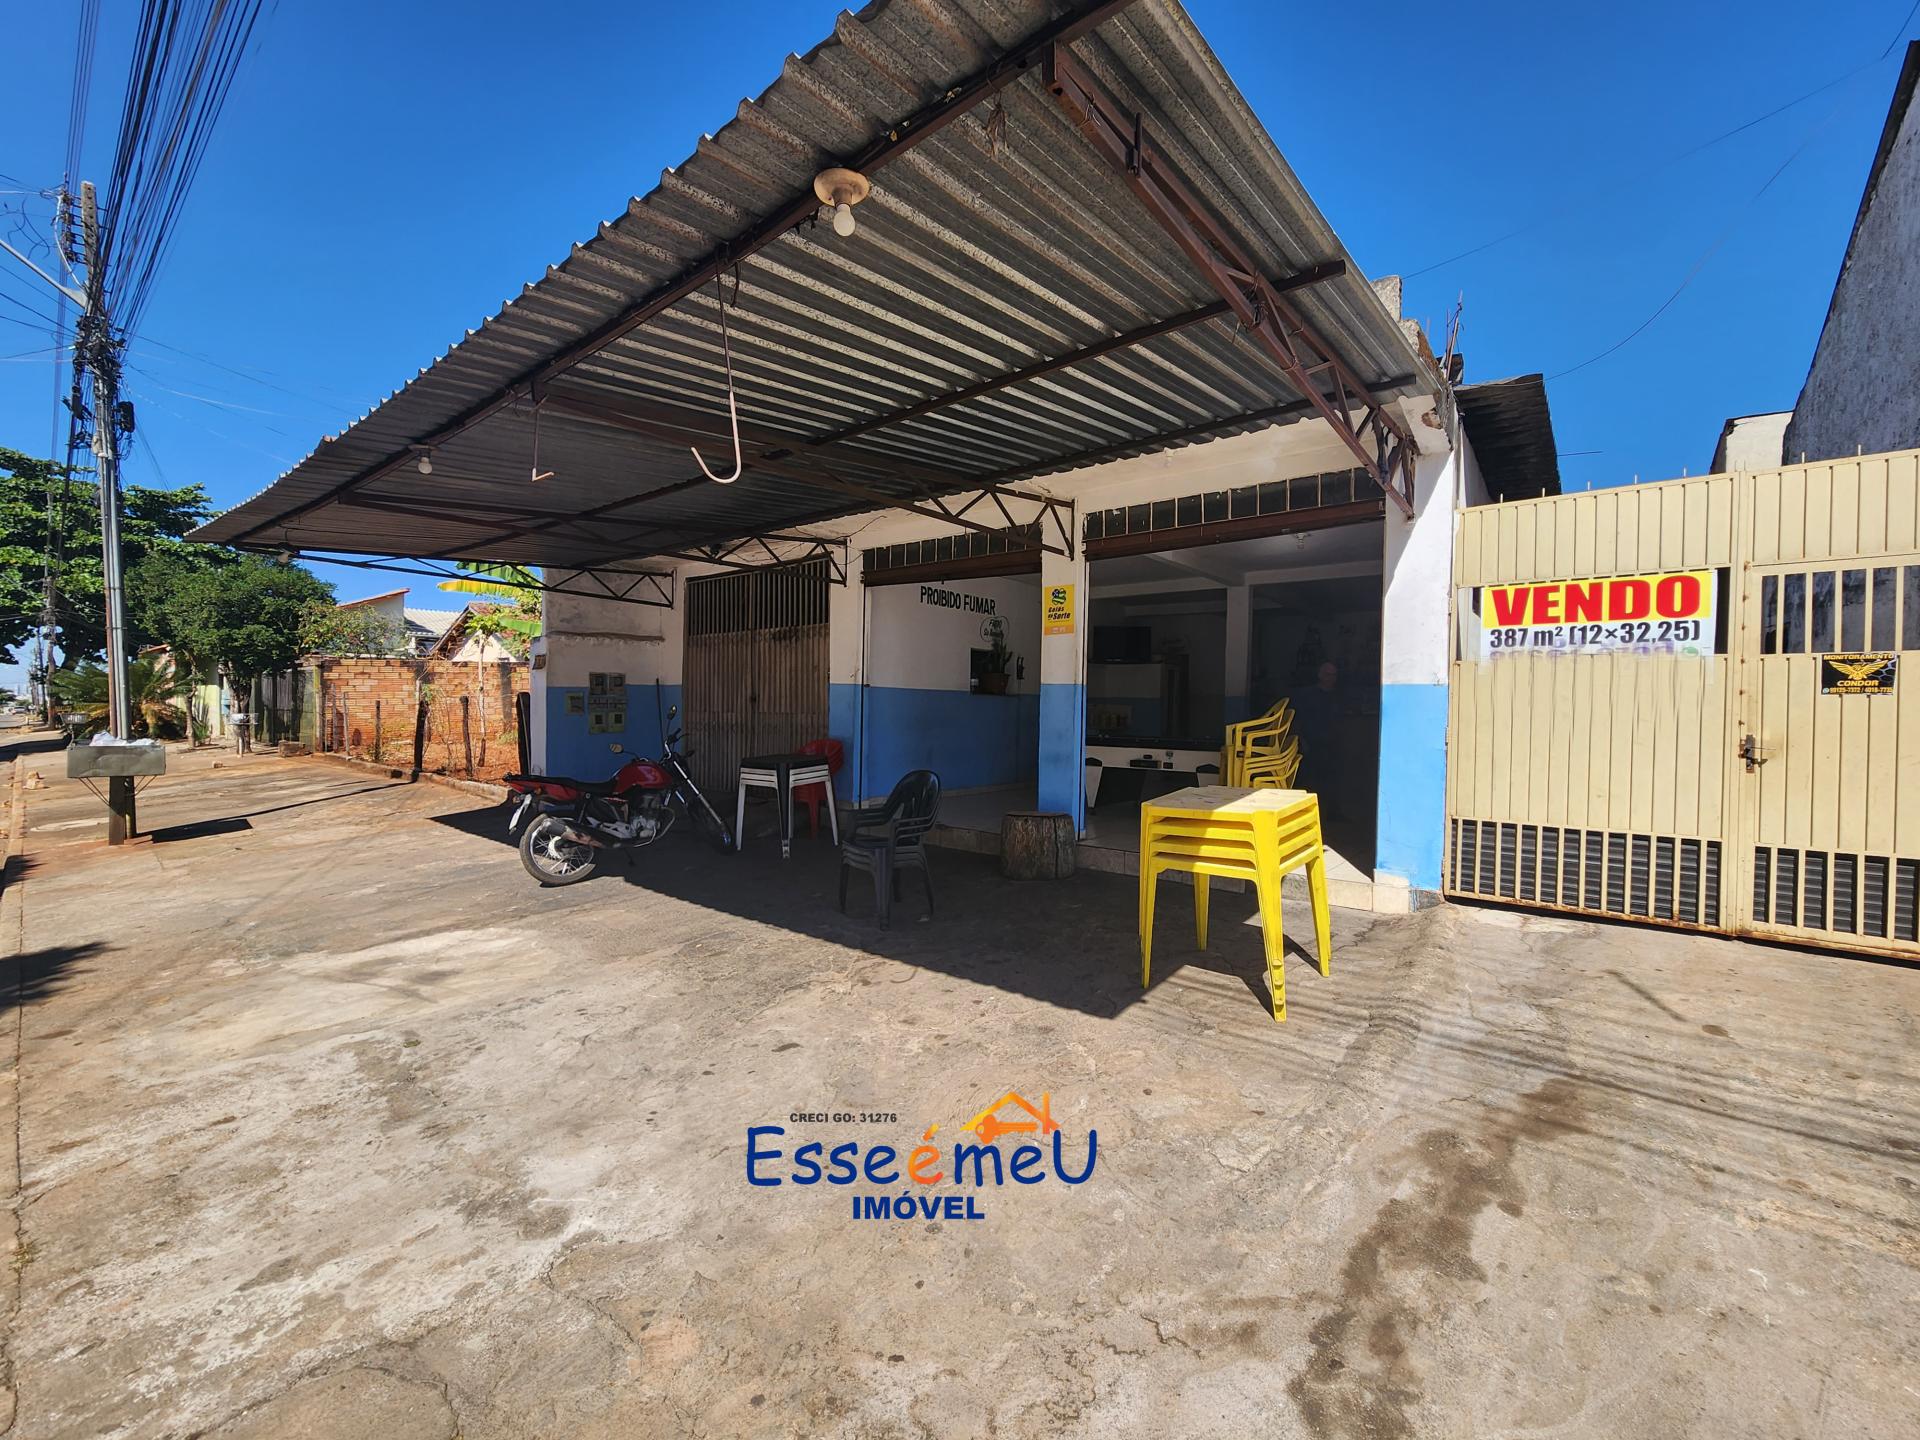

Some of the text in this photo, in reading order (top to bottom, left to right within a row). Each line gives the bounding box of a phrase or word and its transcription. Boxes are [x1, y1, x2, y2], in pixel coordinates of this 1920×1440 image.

[920, 585, 996, 615] PROIBIDO FUMAR
[1491, 575, 1700, 626] VENDO
[1489, 628, 1528, 648] 387
